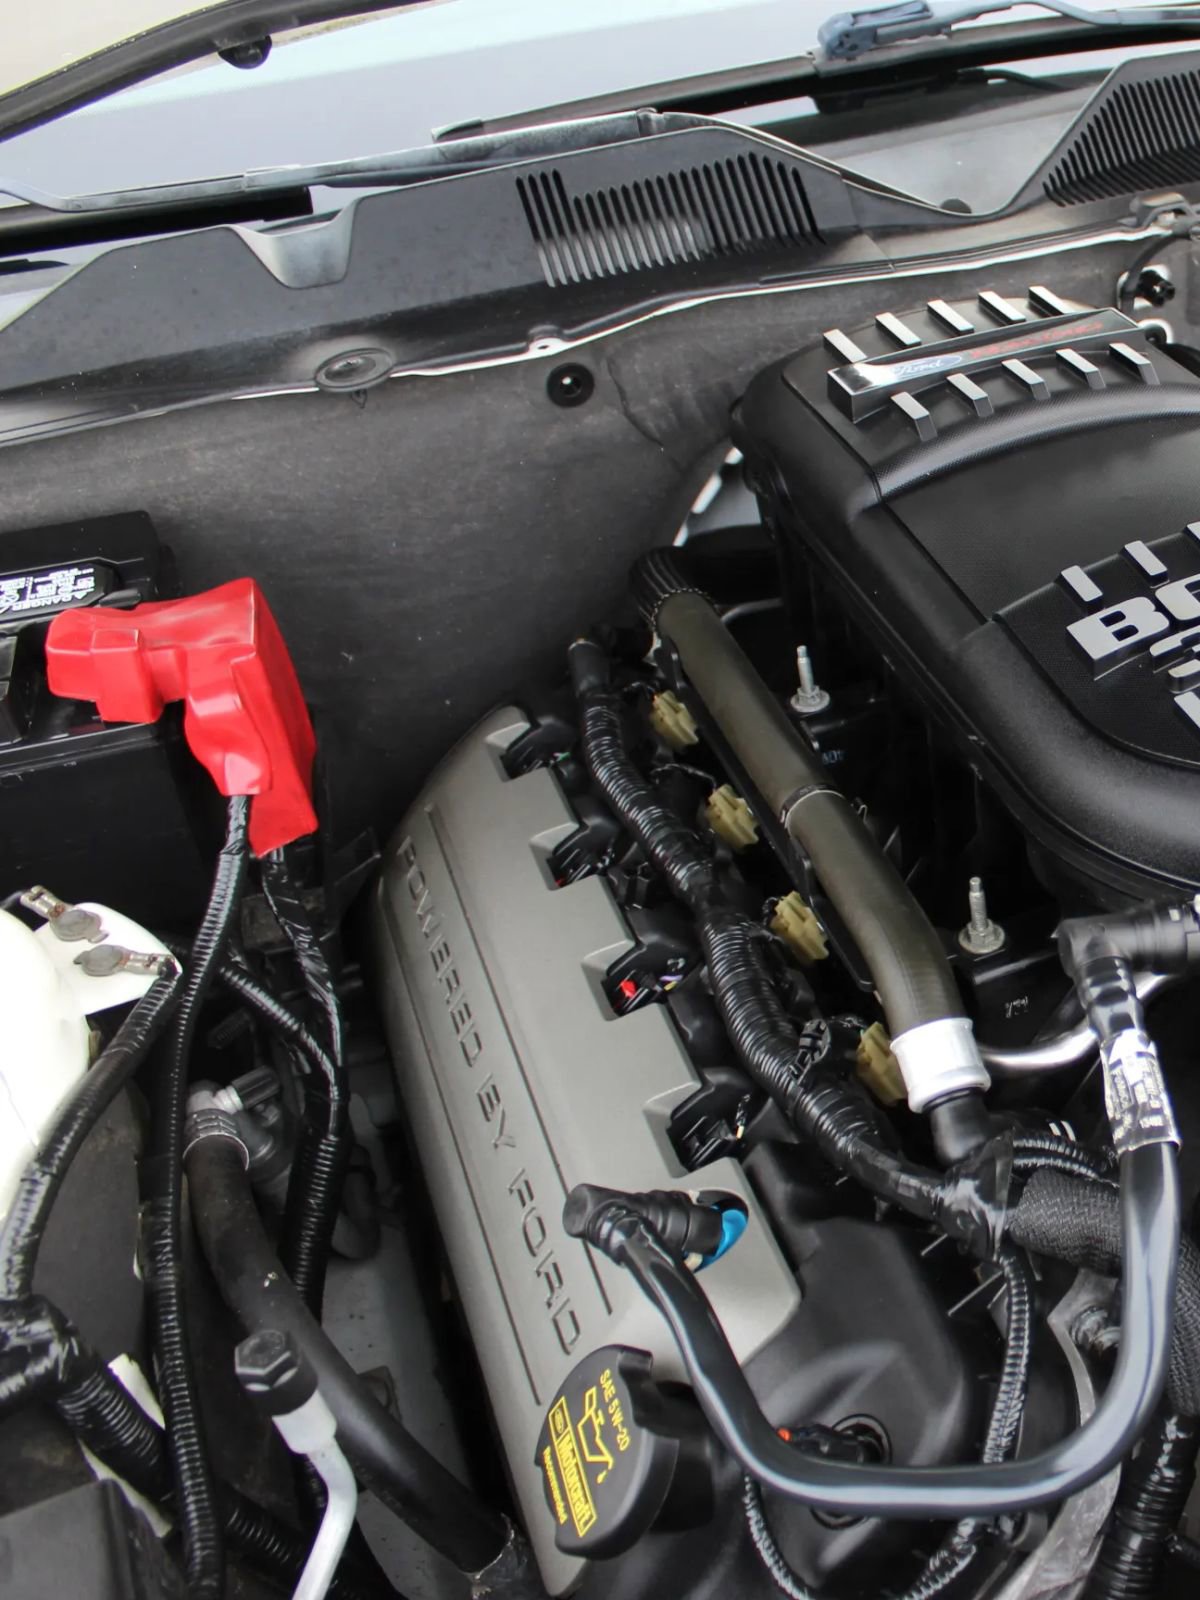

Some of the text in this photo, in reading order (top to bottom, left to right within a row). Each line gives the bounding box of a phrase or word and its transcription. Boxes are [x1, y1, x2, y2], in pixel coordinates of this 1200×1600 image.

[396, 835, 581, 1356] POWERED BY FORD
[599, 1368, 632, 1451] SAE 5W-20
[557, 1433, 593, 1528] Motorcraft
